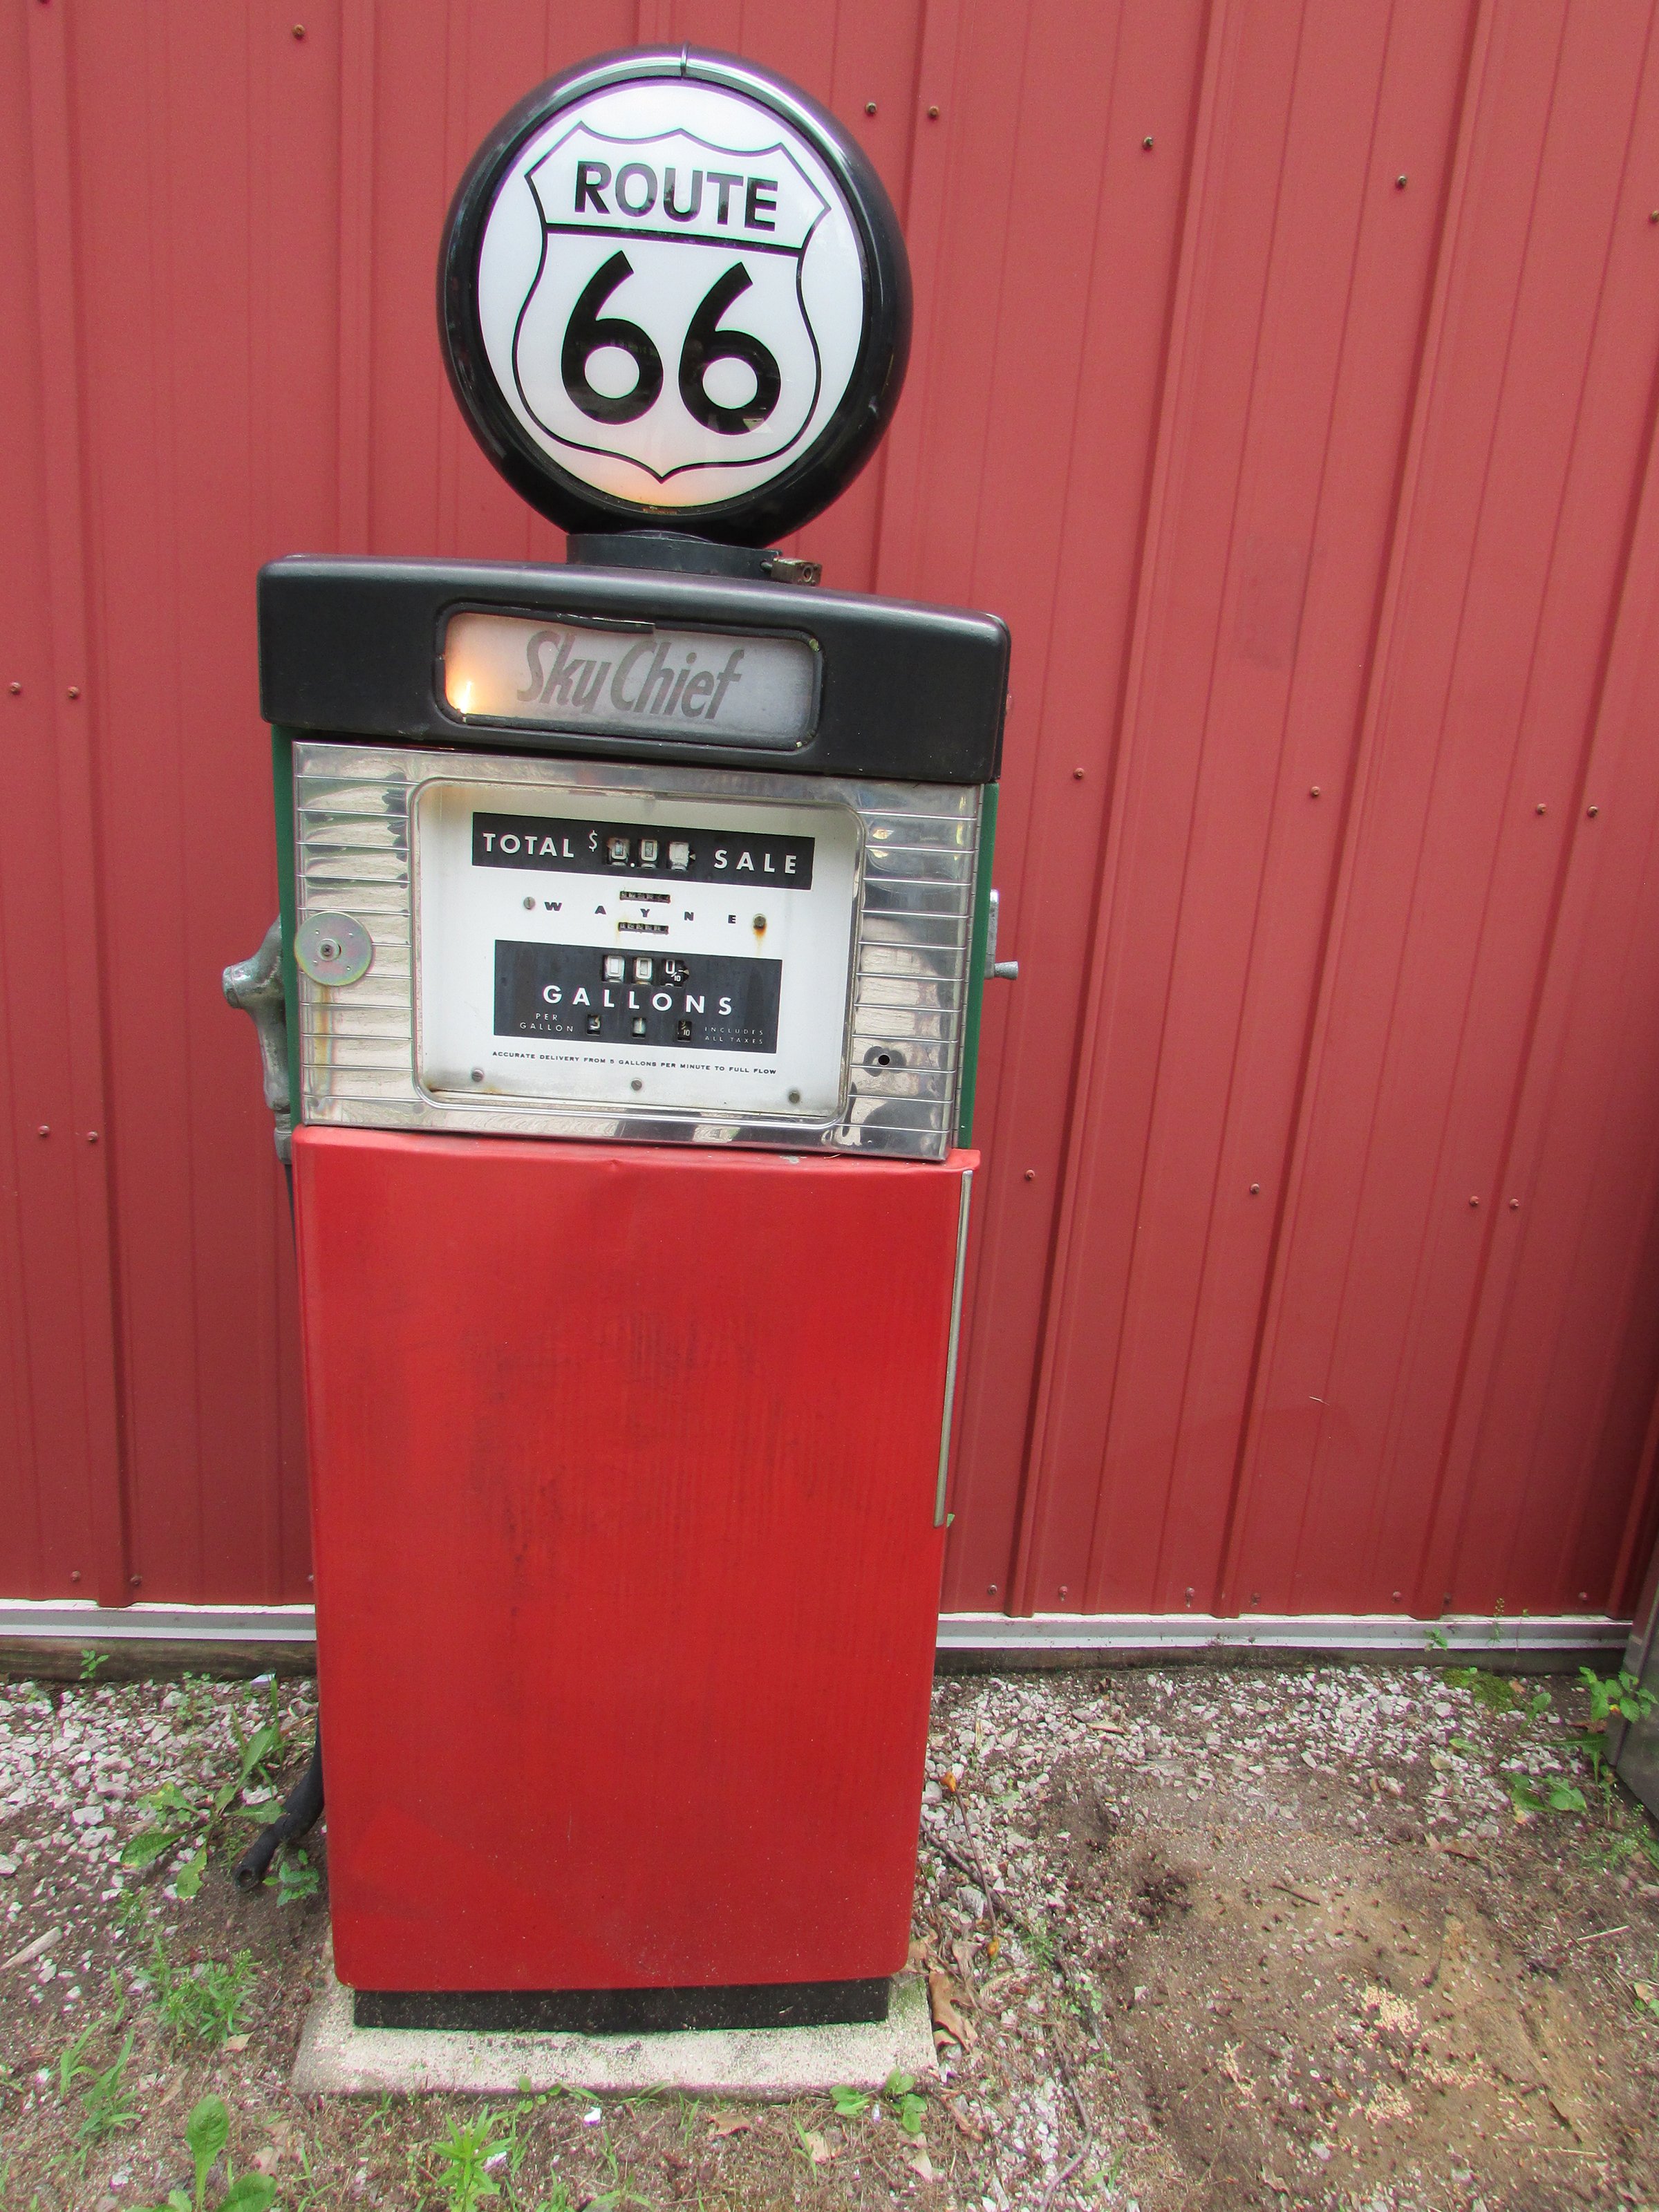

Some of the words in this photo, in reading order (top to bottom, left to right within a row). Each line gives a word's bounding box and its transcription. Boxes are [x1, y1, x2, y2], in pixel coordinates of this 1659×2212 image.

[574, 160, 778, 232] ROUTE
[561, 250, 781, 435] 66
[516, 630, 612, 715] Sky
[610, 639, 744, 720] Chief
[482, 832, 574, 858] TOTAL
[713, 849, 797, 874] SALE
[544, 901, 737, 924] WAYNE
[542, 985, 733, 1015] GALLONS
[519, 1022, 574, 1032] GALLON
[535, 1013, 558, 1021] PER
[704, 1027, 764, 1035] INCLUDES
[492, 1051, 536, 1059] ACCURATE
